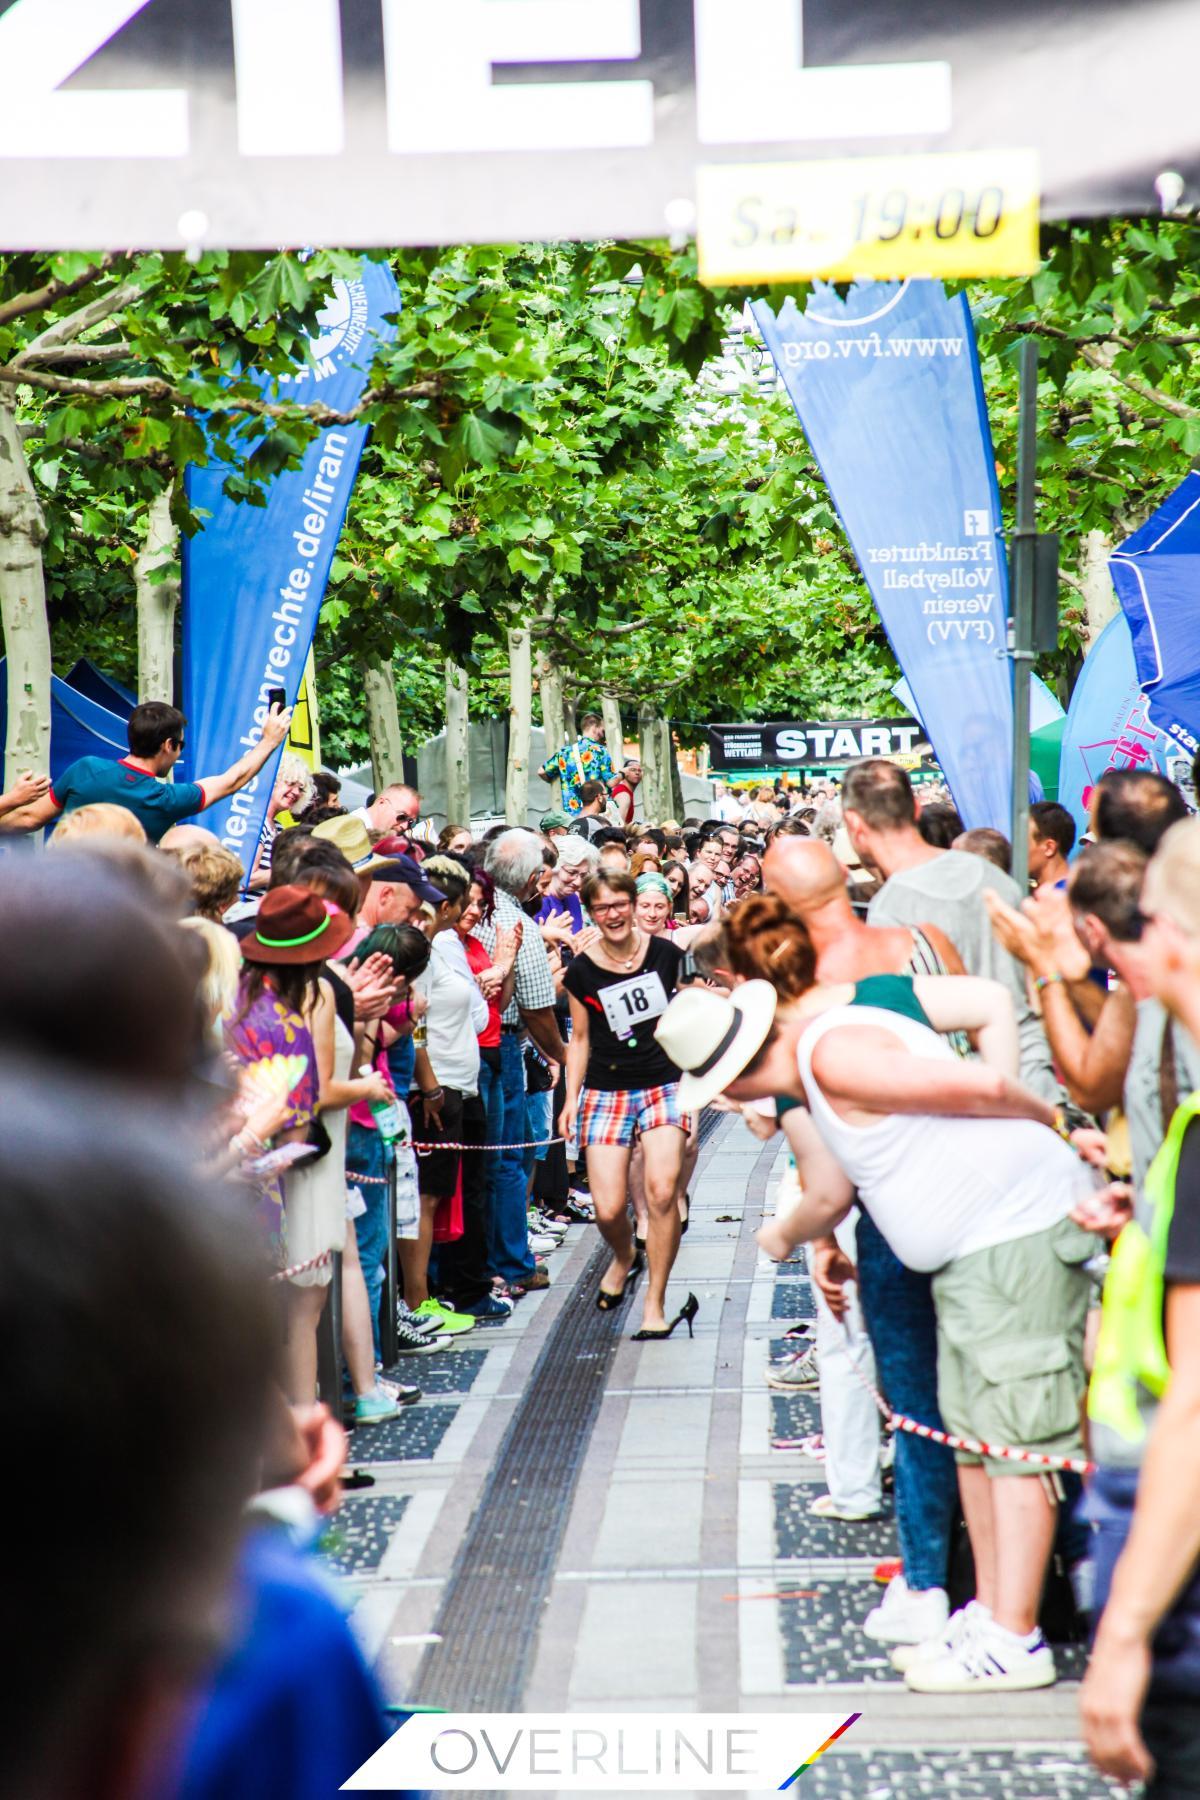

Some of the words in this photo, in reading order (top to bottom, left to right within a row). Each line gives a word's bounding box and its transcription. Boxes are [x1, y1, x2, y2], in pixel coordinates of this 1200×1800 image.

[854, 185, 1004, 242] 19:00
[340, 278, 368, 355] SCHENRECHTE
[724, 748, 762, 758] WETTLAUF
[775, 726, 920, 760] START
[618, 987, 650, 1016] 18
